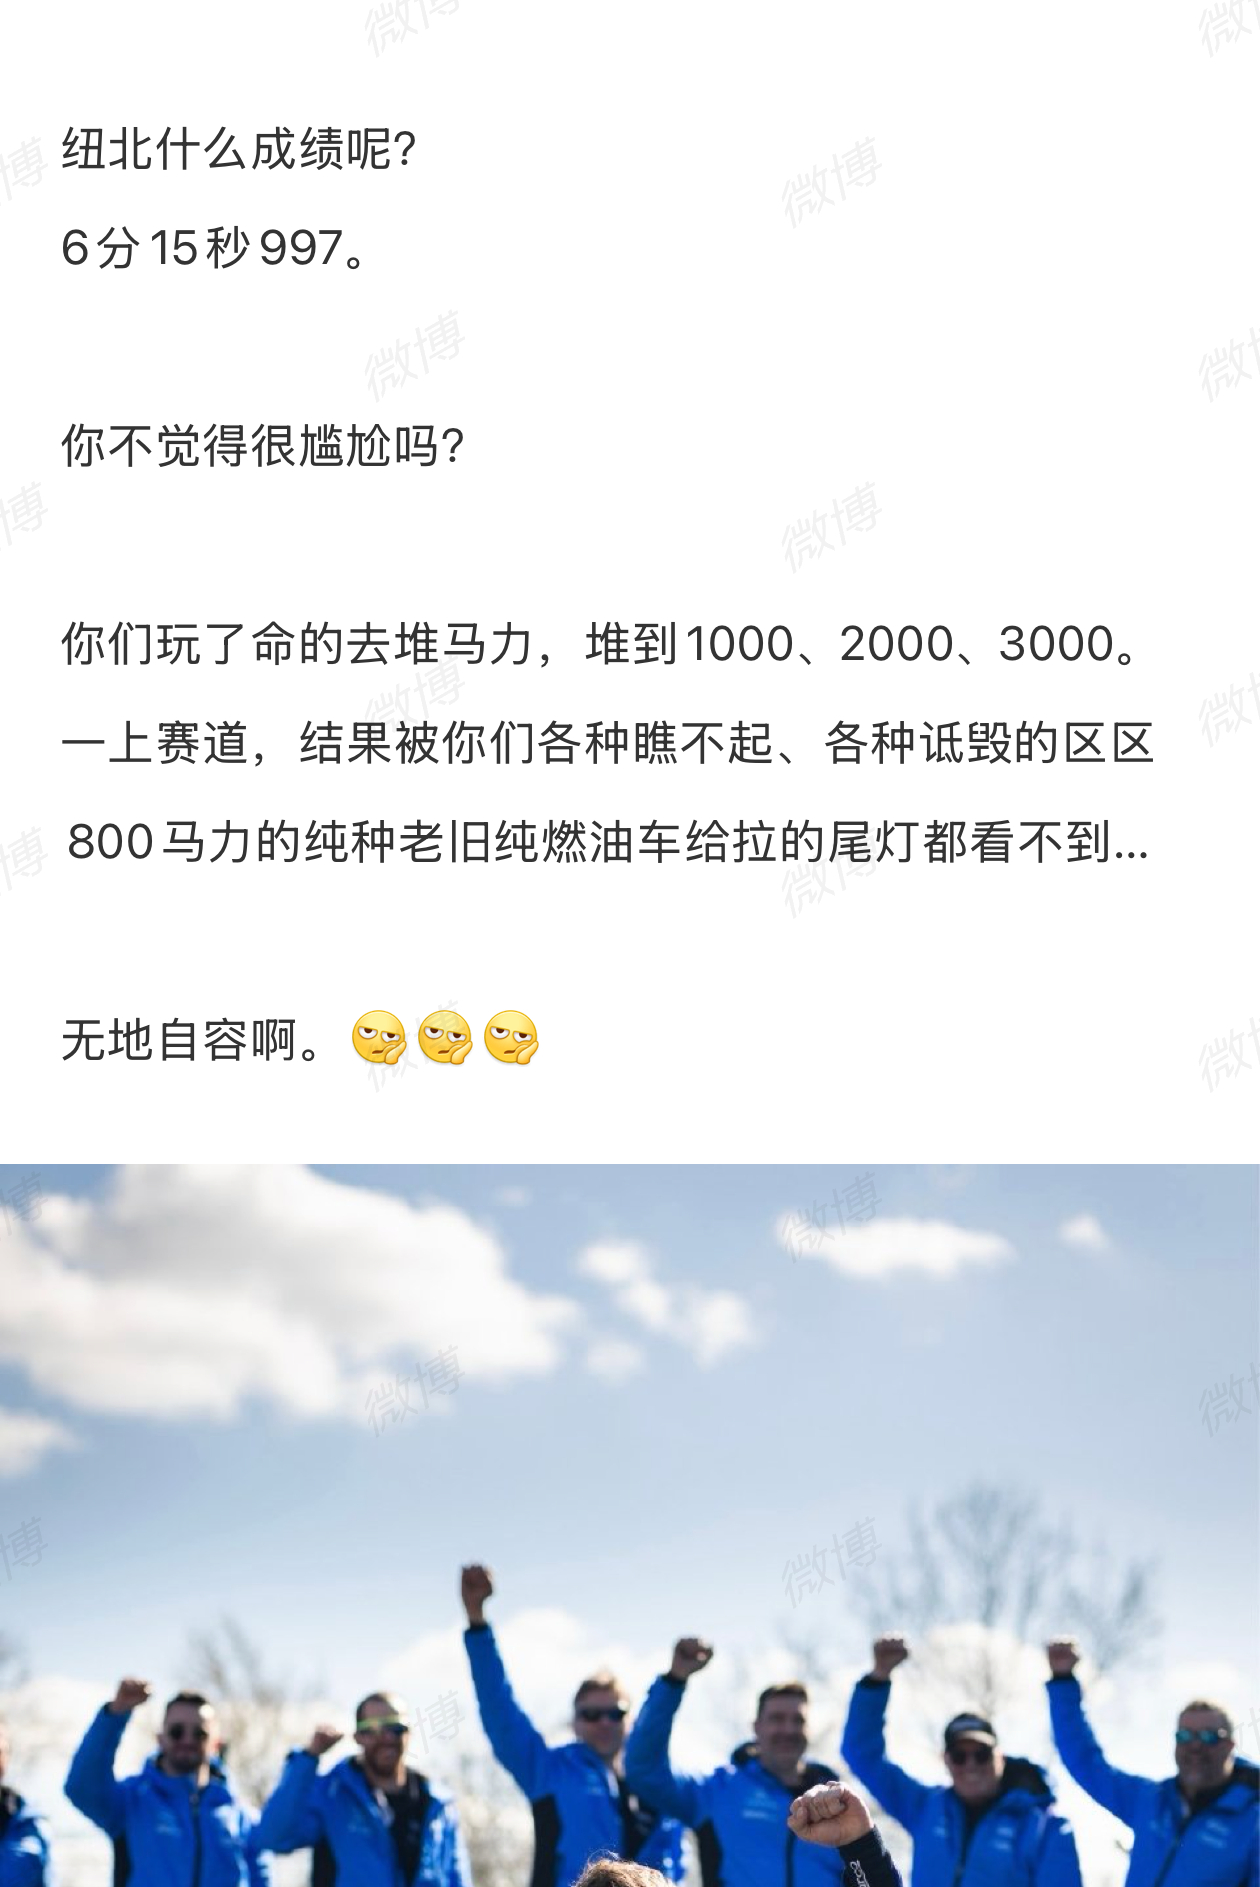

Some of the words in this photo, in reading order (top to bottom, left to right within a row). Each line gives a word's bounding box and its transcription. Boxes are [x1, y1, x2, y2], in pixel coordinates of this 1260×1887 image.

[63, 127, 415, 170] 纽北什么成绩呢？
[62, 424, 463, 467] 你不觉得很尴尬吗？
[63, 1018, 315, 1062] 无地自容啊。
